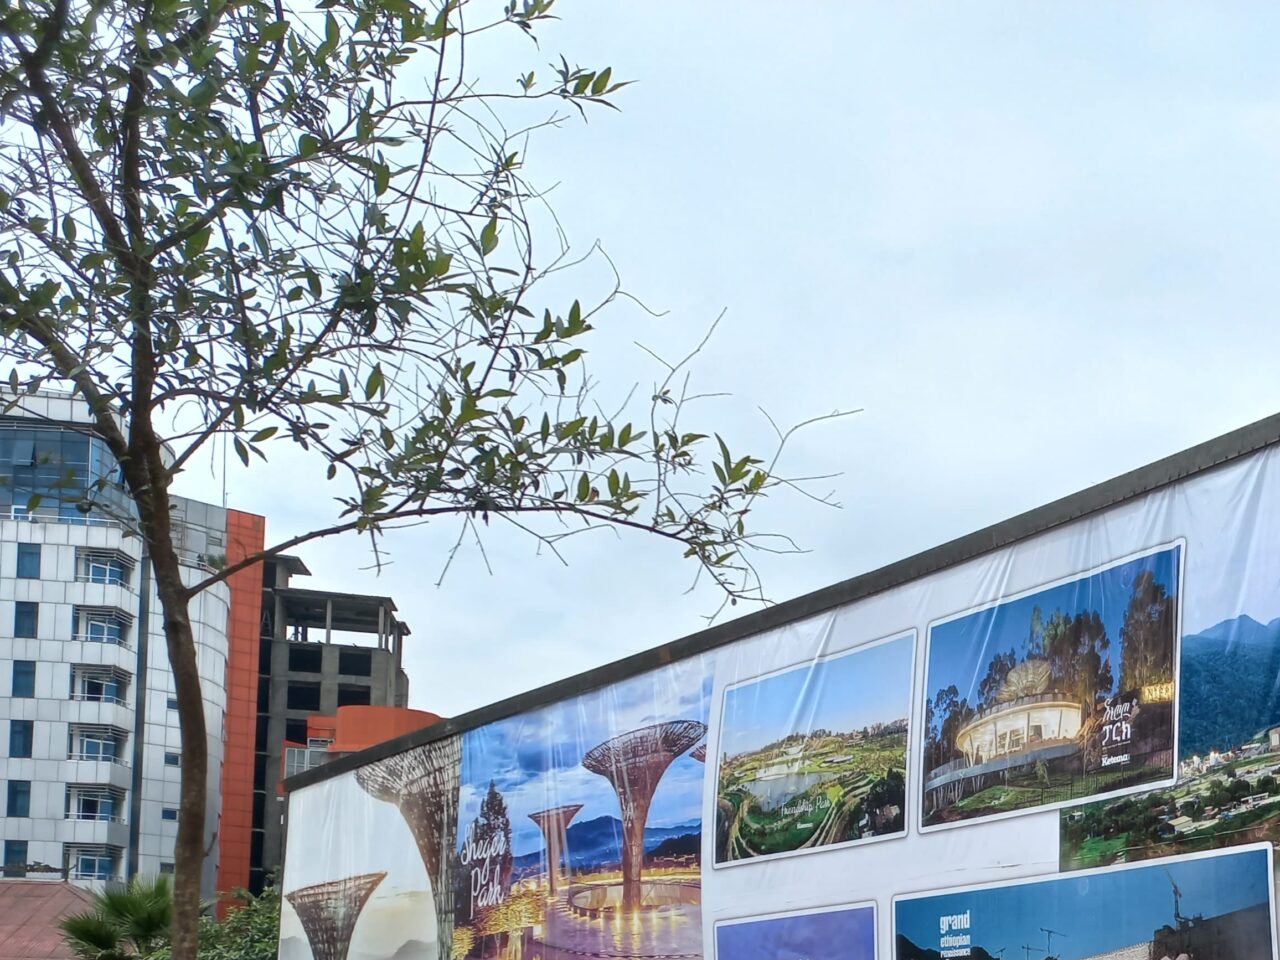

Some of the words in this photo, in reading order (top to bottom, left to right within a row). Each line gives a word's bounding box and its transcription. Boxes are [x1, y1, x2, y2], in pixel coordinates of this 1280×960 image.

[470, 865, 504, 919] Park
[940, 909, 970, 934] grand
[940, 933, 970, 948] ethiopian
